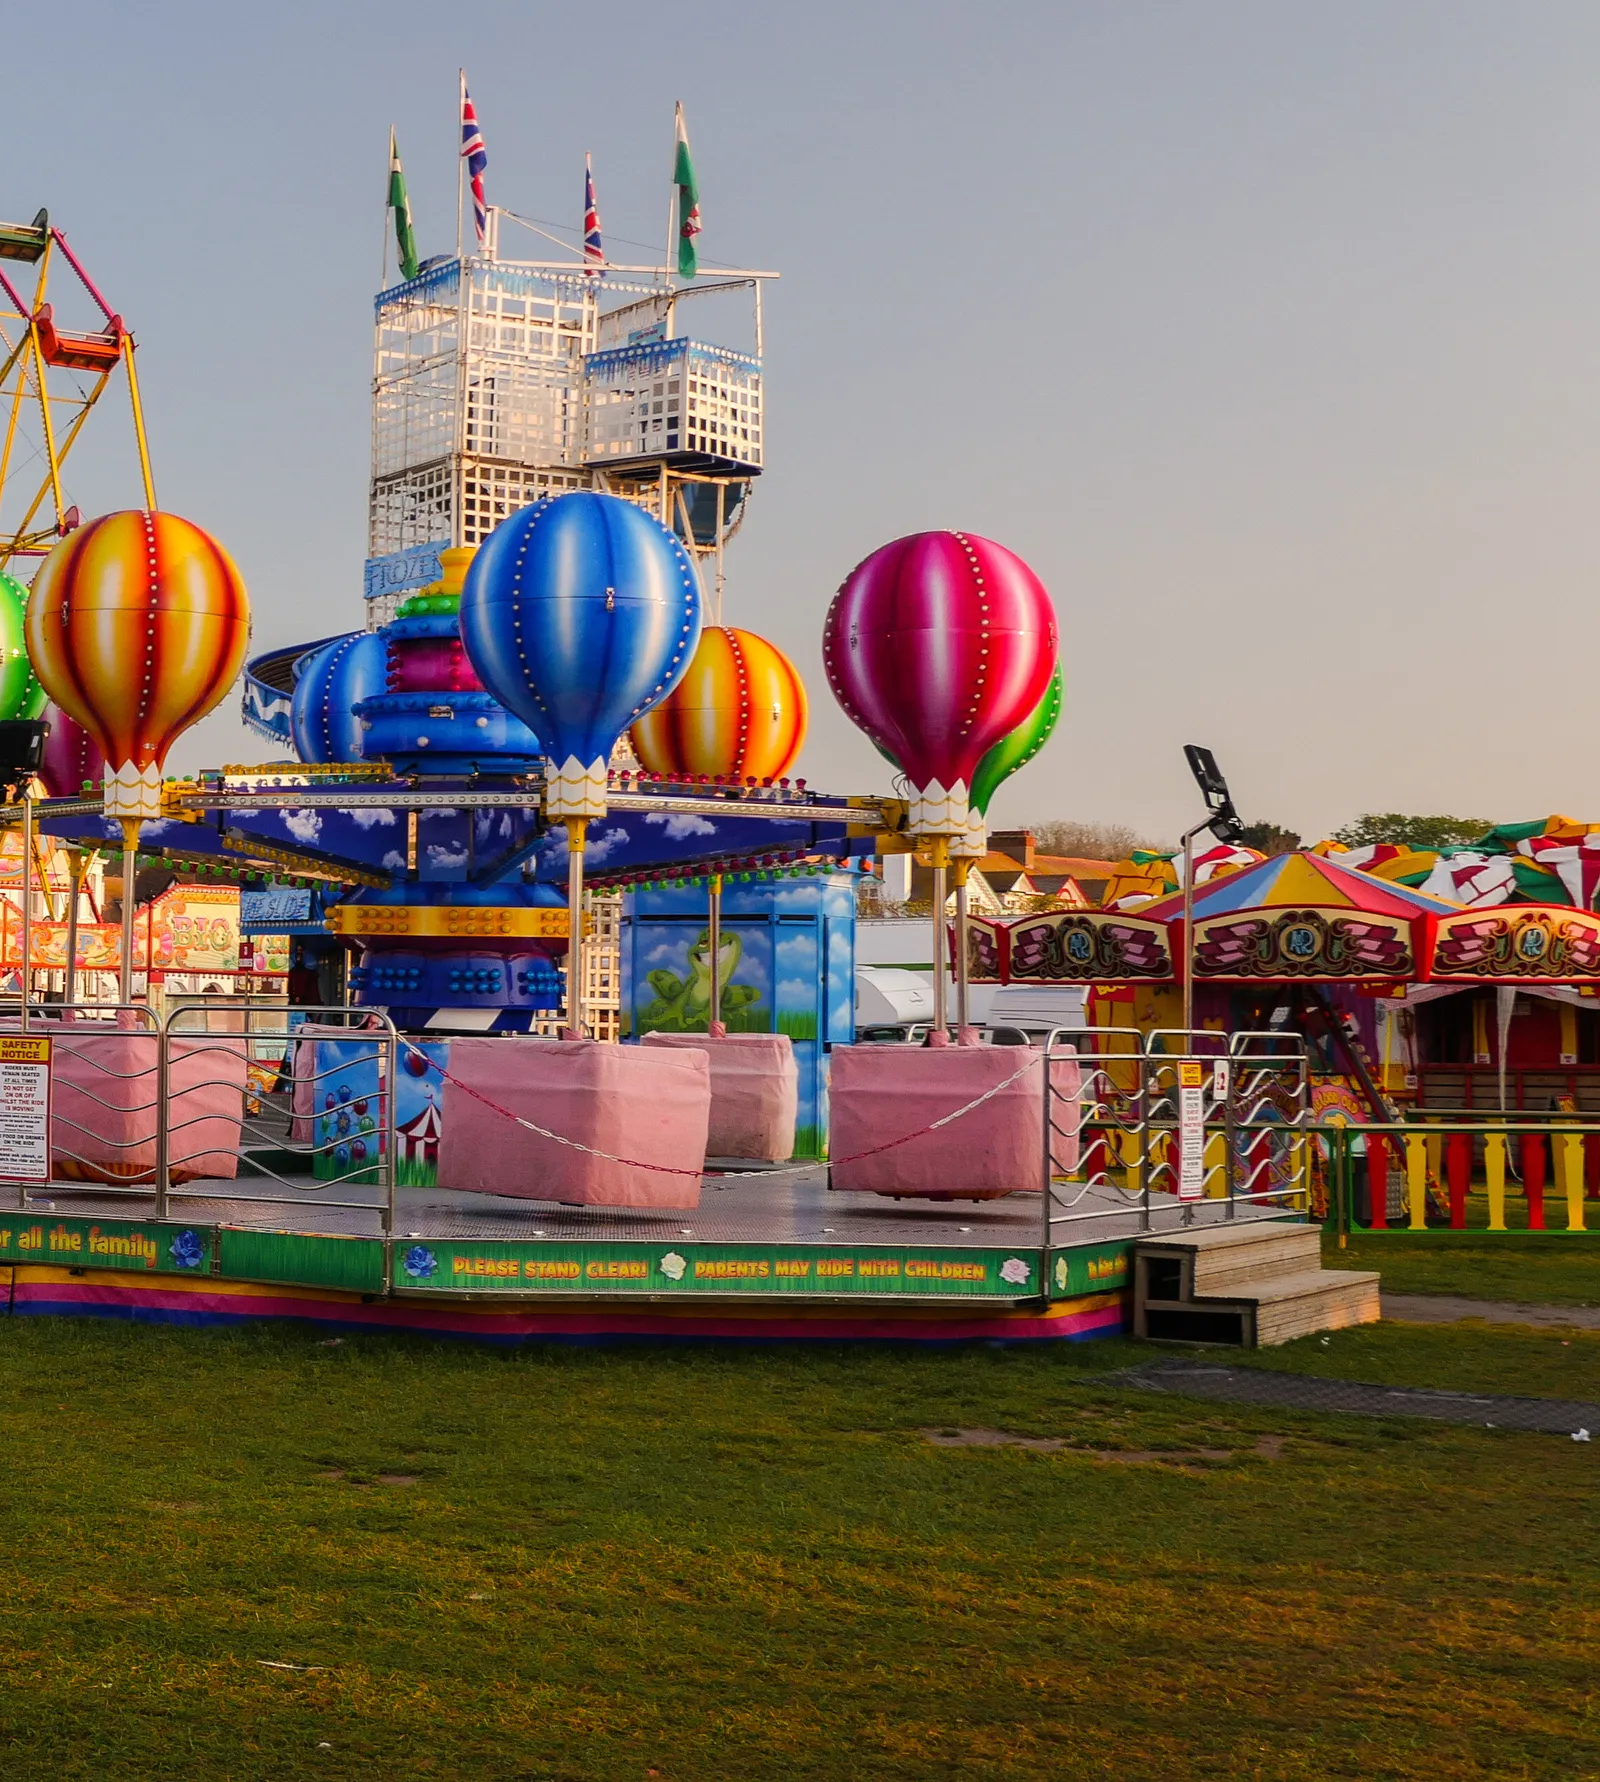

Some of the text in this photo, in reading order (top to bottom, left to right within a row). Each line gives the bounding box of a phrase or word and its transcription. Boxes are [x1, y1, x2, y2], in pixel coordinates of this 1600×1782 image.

[1, 1050, 40, 1059] NOTICE
[2, 1041, 42, 1049] SAFETY
[18, 1226, 42, 1251] all
[49, 1224, 81, 1252] the
[88, 1225, 158, 1269] family
[453, 1256, 649, 1280] PLEASE STAND CLEAR!
[694, 1259, 986, 1281] PARENTS MAY RIDE WITH CHILDREN
